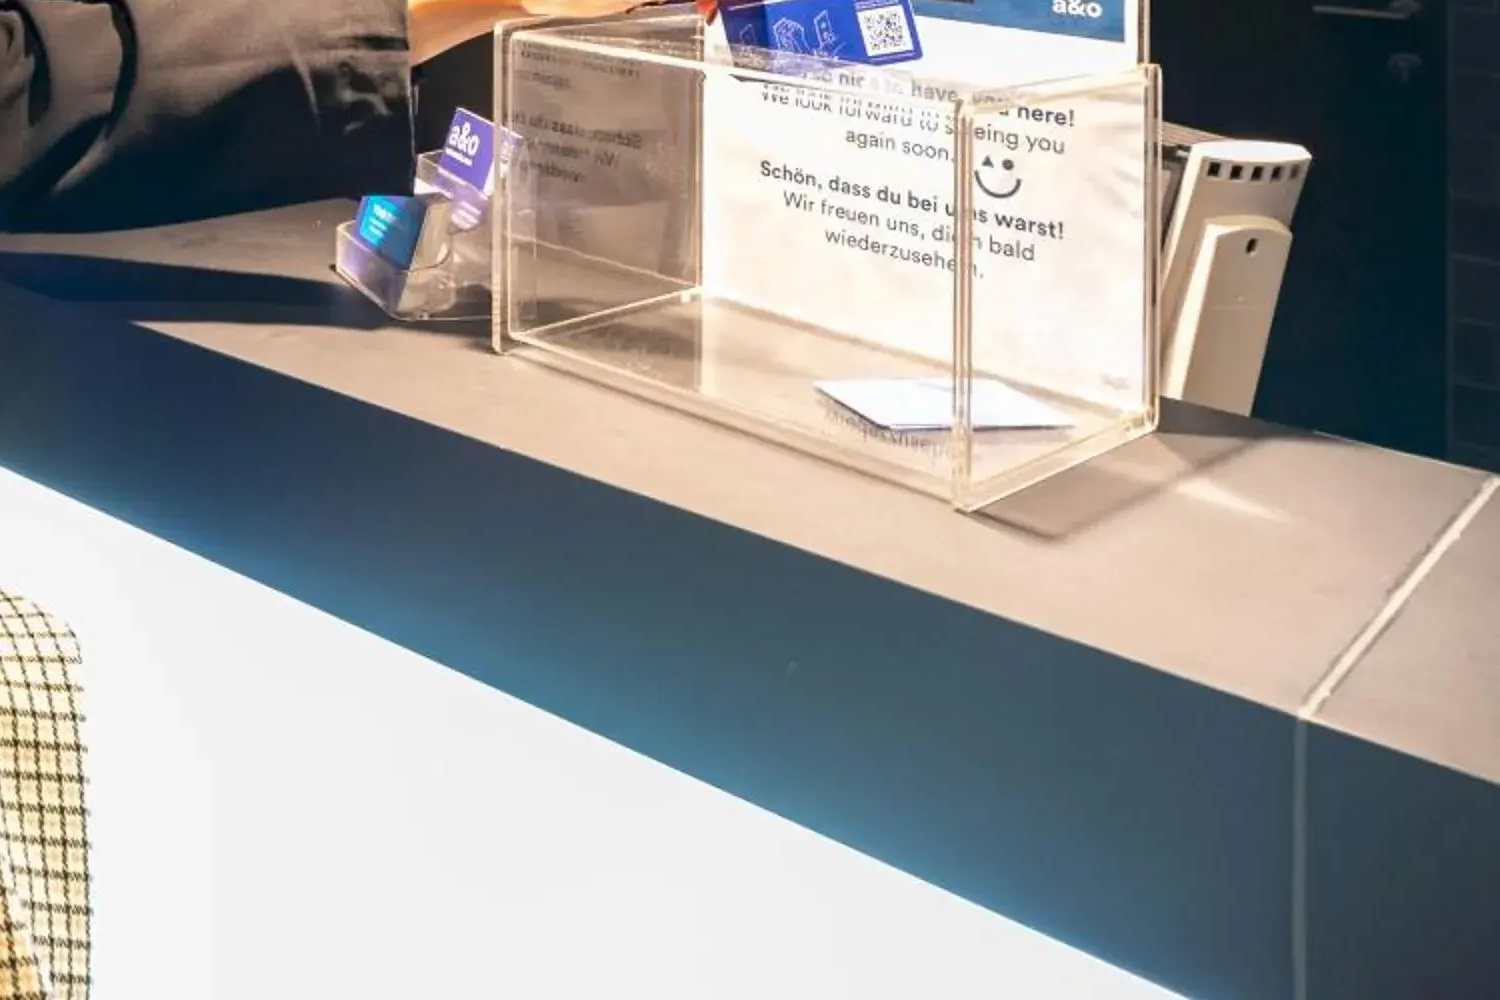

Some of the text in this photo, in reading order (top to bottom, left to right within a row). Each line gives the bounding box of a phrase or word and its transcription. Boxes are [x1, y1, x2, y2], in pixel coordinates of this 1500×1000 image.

[911, 77, 958, 103] have
[449, 121, 480, 157] a&o
[845, 128, 896, 151] again
[944, 115, 1019, 150] seing
[1025, 130, 1066, 156] you
[760, 159, 1064, 240] Schön, dass du bei us warst!
[783, 190, 816, 212] Wir
[820, 198, 880, 228] freuen
[886, 216, 925, 241] uns,
[989, 233, 1036, 262] bald
[824, 228, 984, 280] wiederzusehe.
